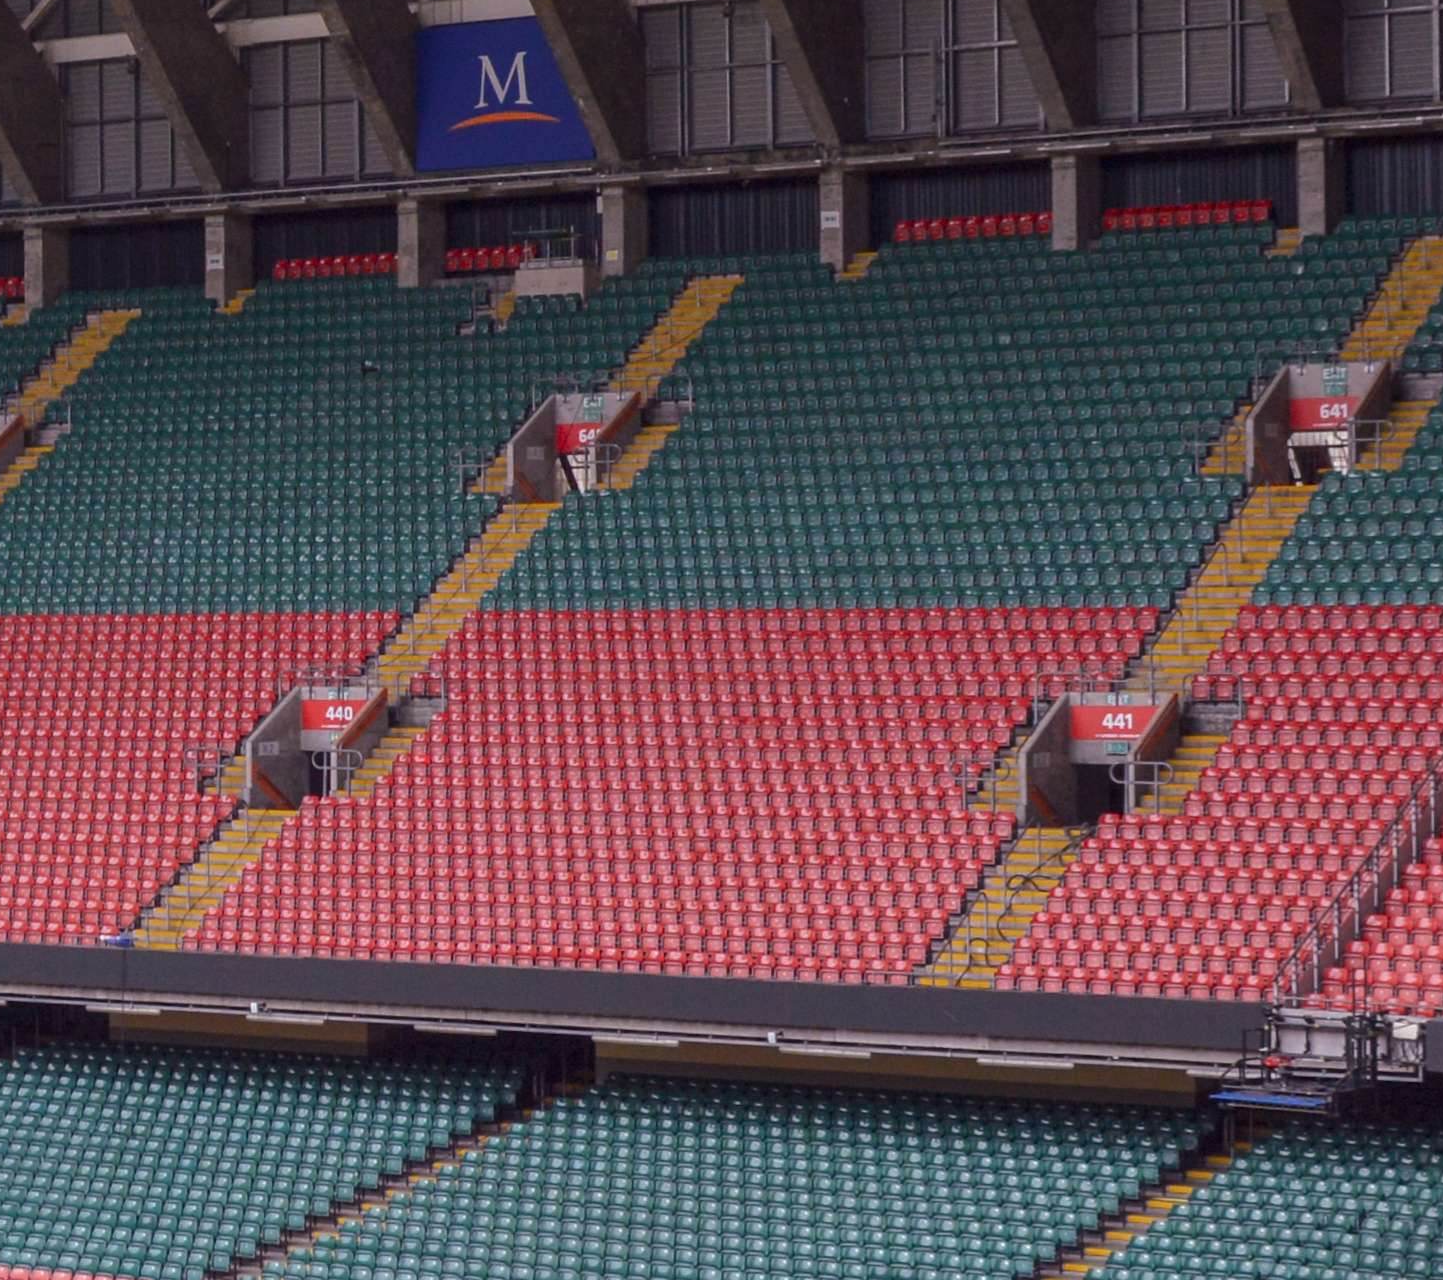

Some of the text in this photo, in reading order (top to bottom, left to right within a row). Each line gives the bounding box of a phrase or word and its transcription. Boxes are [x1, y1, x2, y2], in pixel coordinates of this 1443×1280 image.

[474, 52, 534, 109] M
[1319, 403, 1349, 419] 641
[325, 706, 354, 721] 440
[1101, 712, 1133, 730] 441
